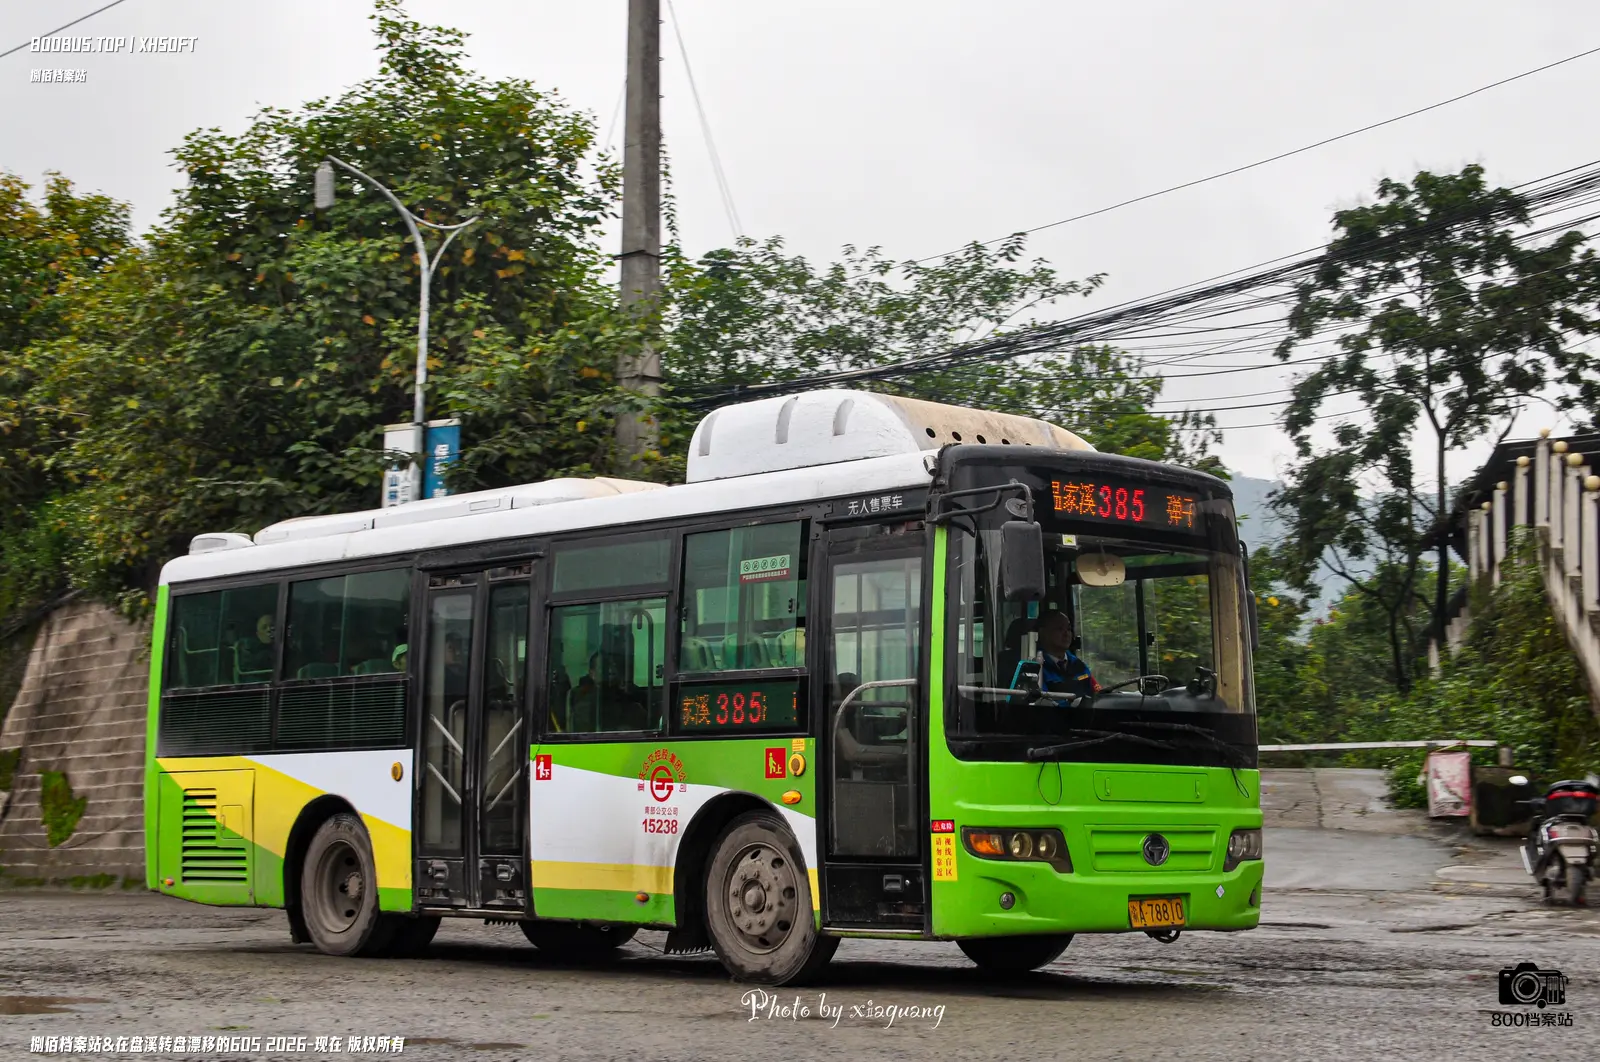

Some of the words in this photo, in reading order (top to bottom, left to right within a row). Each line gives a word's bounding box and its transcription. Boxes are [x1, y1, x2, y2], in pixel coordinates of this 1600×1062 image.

[848, 494, 903, 516] 无人售票车
[1098, 485, 1145, 522] 385
[716, 691, 762, 725] 385
[642, 818, 678, 835] 15238
